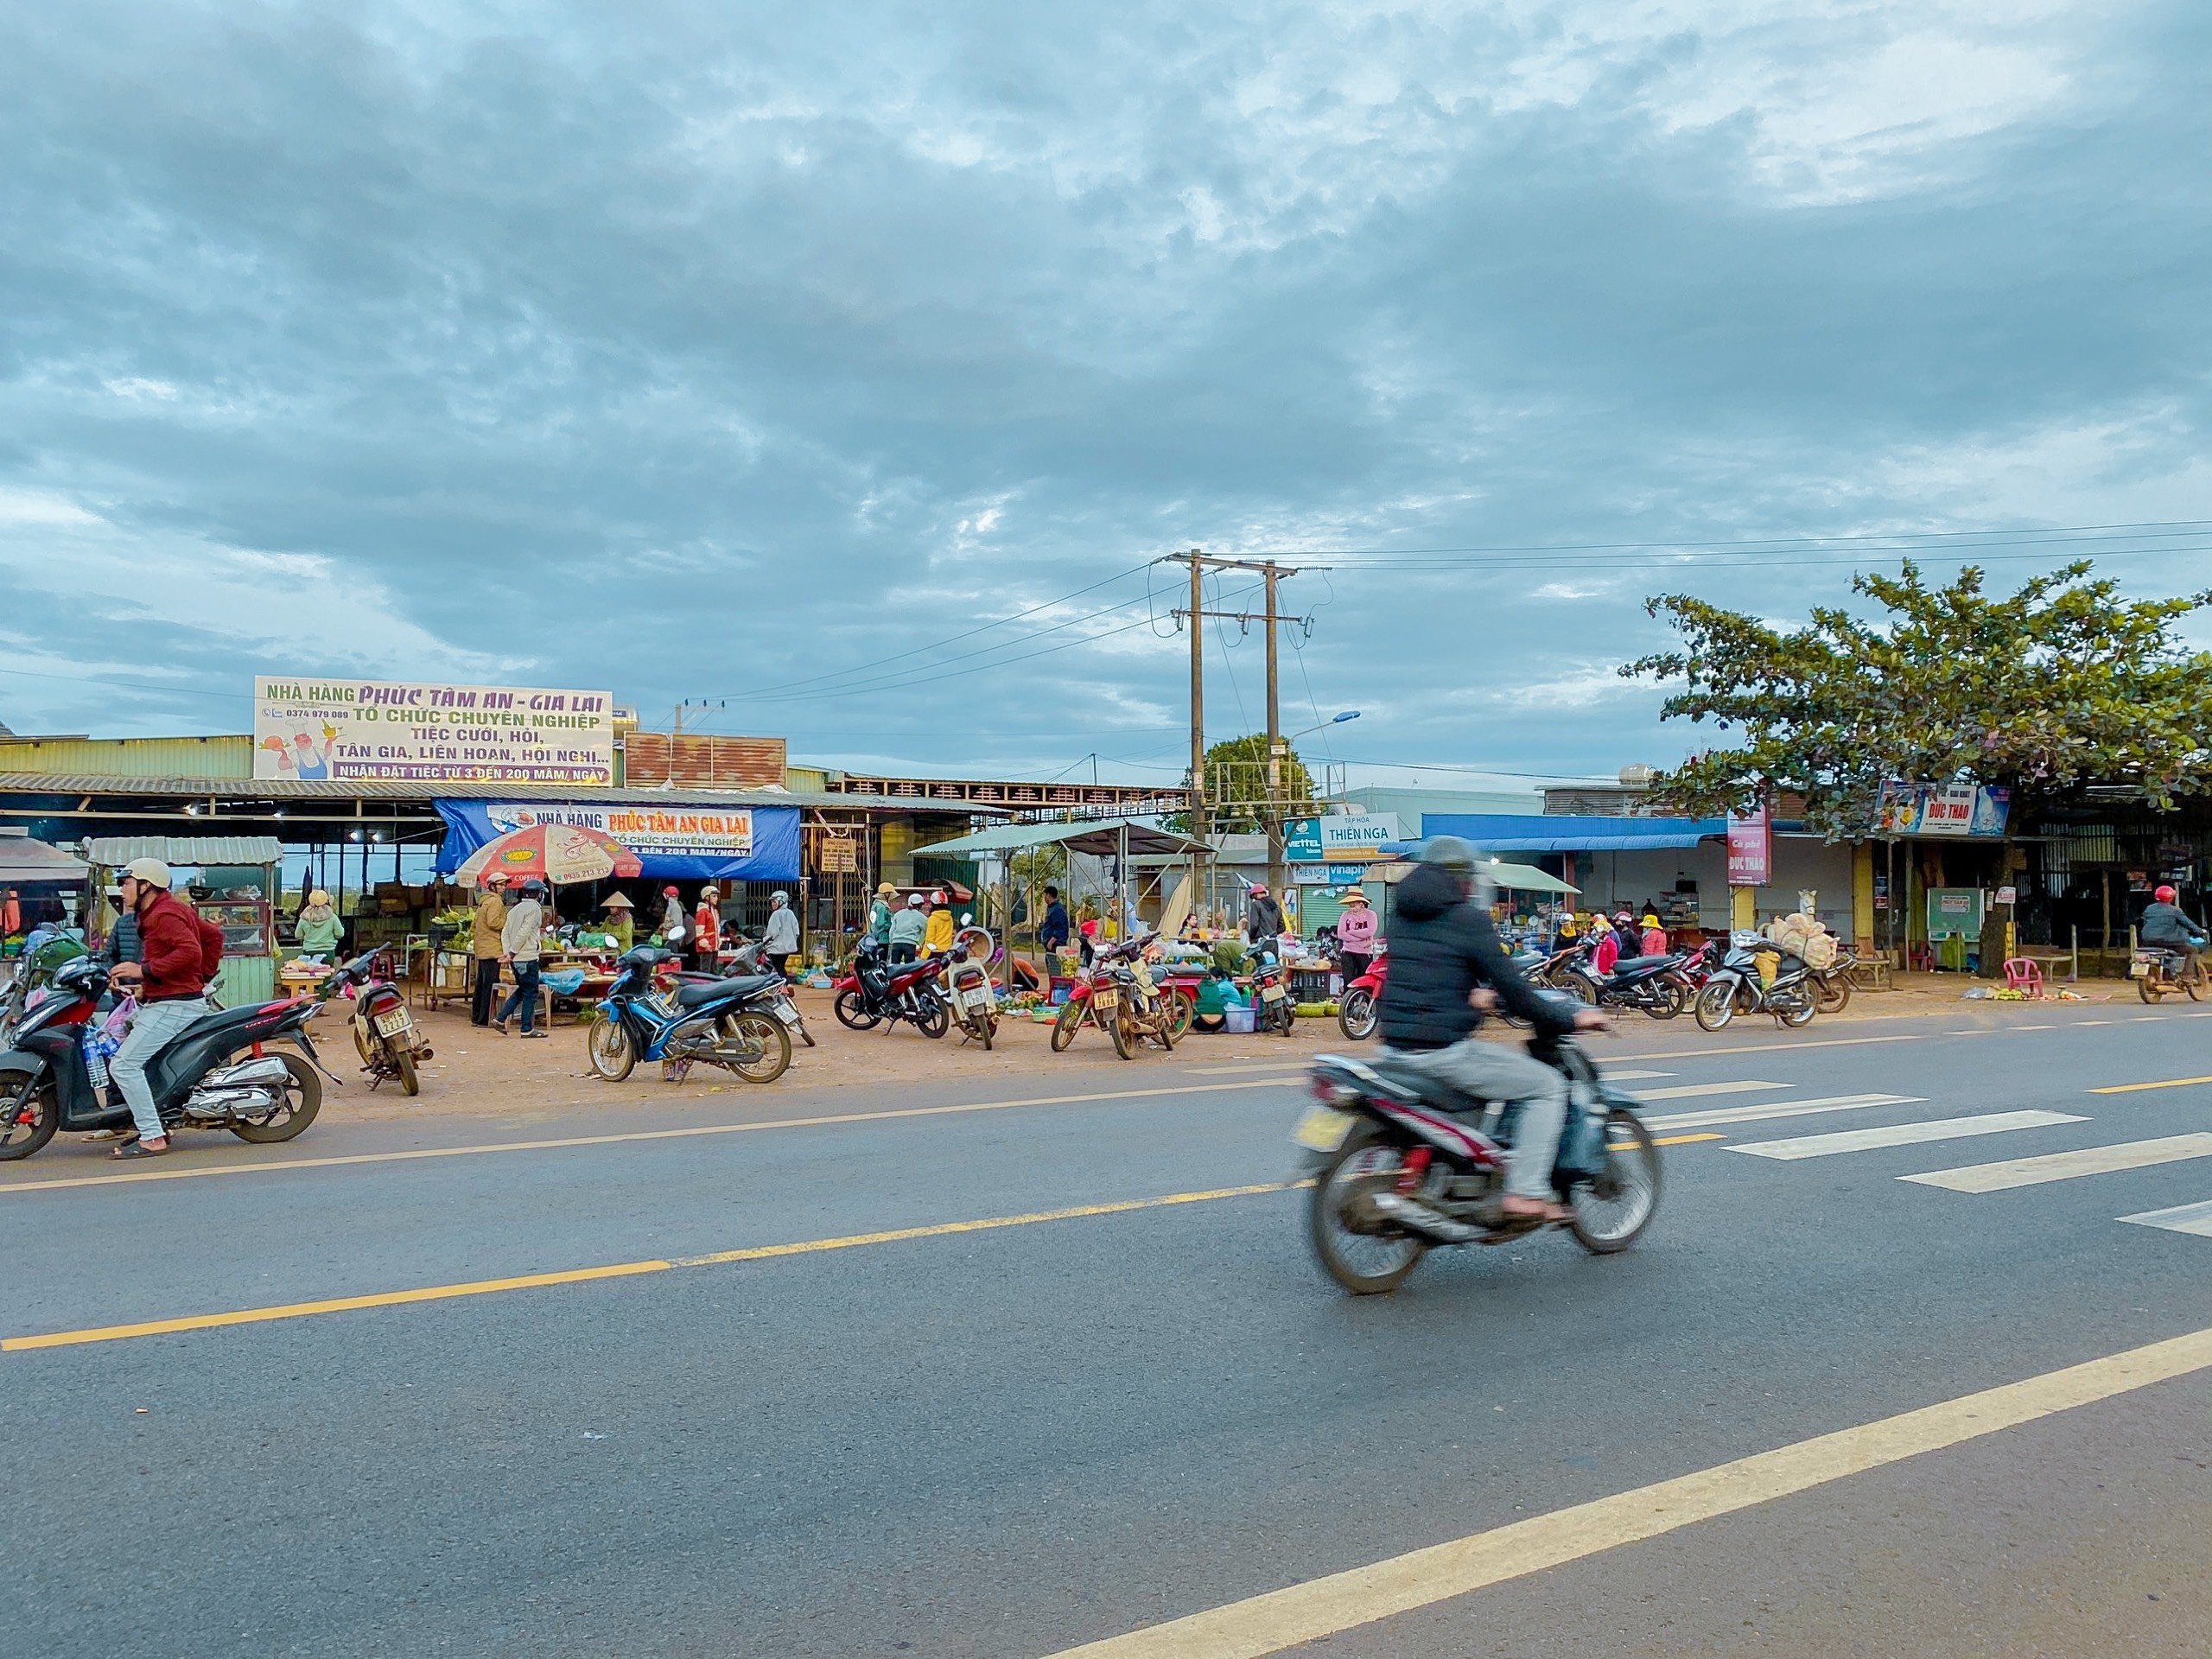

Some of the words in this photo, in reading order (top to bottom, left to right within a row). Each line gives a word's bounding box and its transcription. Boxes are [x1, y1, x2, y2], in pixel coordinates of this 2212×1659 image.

[267, 682, 302, 700] NHÀ
[308, 683, 354, 702] HÀNG
[359, 685, 422, 706] PHÚC
[429, 687, 477, 707] TÂM
[482, 692, 514, 709] AN
[529, 694, 564, 711] GIA
[570, 696, 603, 712] LAI
[353, 703, 378, 721] TỔ
[386, 707, 441, 723] CHỨC
[448, 710, 524, 727] CHUYÊN
[532, 713, 601, 731] NGHIỆP
[411, 725, 450, 742] TIỆC
[456, 726, 504, 743] CƯỚI,
[510, 727, 544, 744] HỎI,
[337, 742, 371, 757] TÂN
[378, 746, 413, 760] GIA,
[419, 745, 457, 760] LIÊN
[463, 747, 516, 762] HOAN,
[522, 747, 550, 764] HỘI
[557, 750, 609, 765] NGHỊ...
[340, 764, 376, 779] NHẬN
[381, 765, 406, 779] ĐẶT
[410, 766, 439, 779] TIỆC
[443, 766, 461, 779] TỪ
[464, 768, 472, 778] 3
[476, 766, 502, 779] ĐẾN
[506, 769, 530, 779] 200
[534, 767, 569, 780] MÂM/
[573, 768, 606, 780] NGÀY
[537, 810, 563, 825] NHÀ
[568, 810, 602, 828] HÀNG
[608, 809, 645, 832] PHÚC
[647, 810, 677, 833] TÂM
[678, 816, 699, 833] AN
[700, 816, 725, 834] GIA
[726, 816, 749, 835] LAI
[629, 835, 659, 844] CHỨC
[663, 836, 704, 845] CHUYÊN
[708, 836, 745, 846] NGHIỆP
[1329, 827, 1361, 840] THIÊN
[1364, 827, 1389, 839] NGA
[1330, 864, 1365, 876] vinaph
